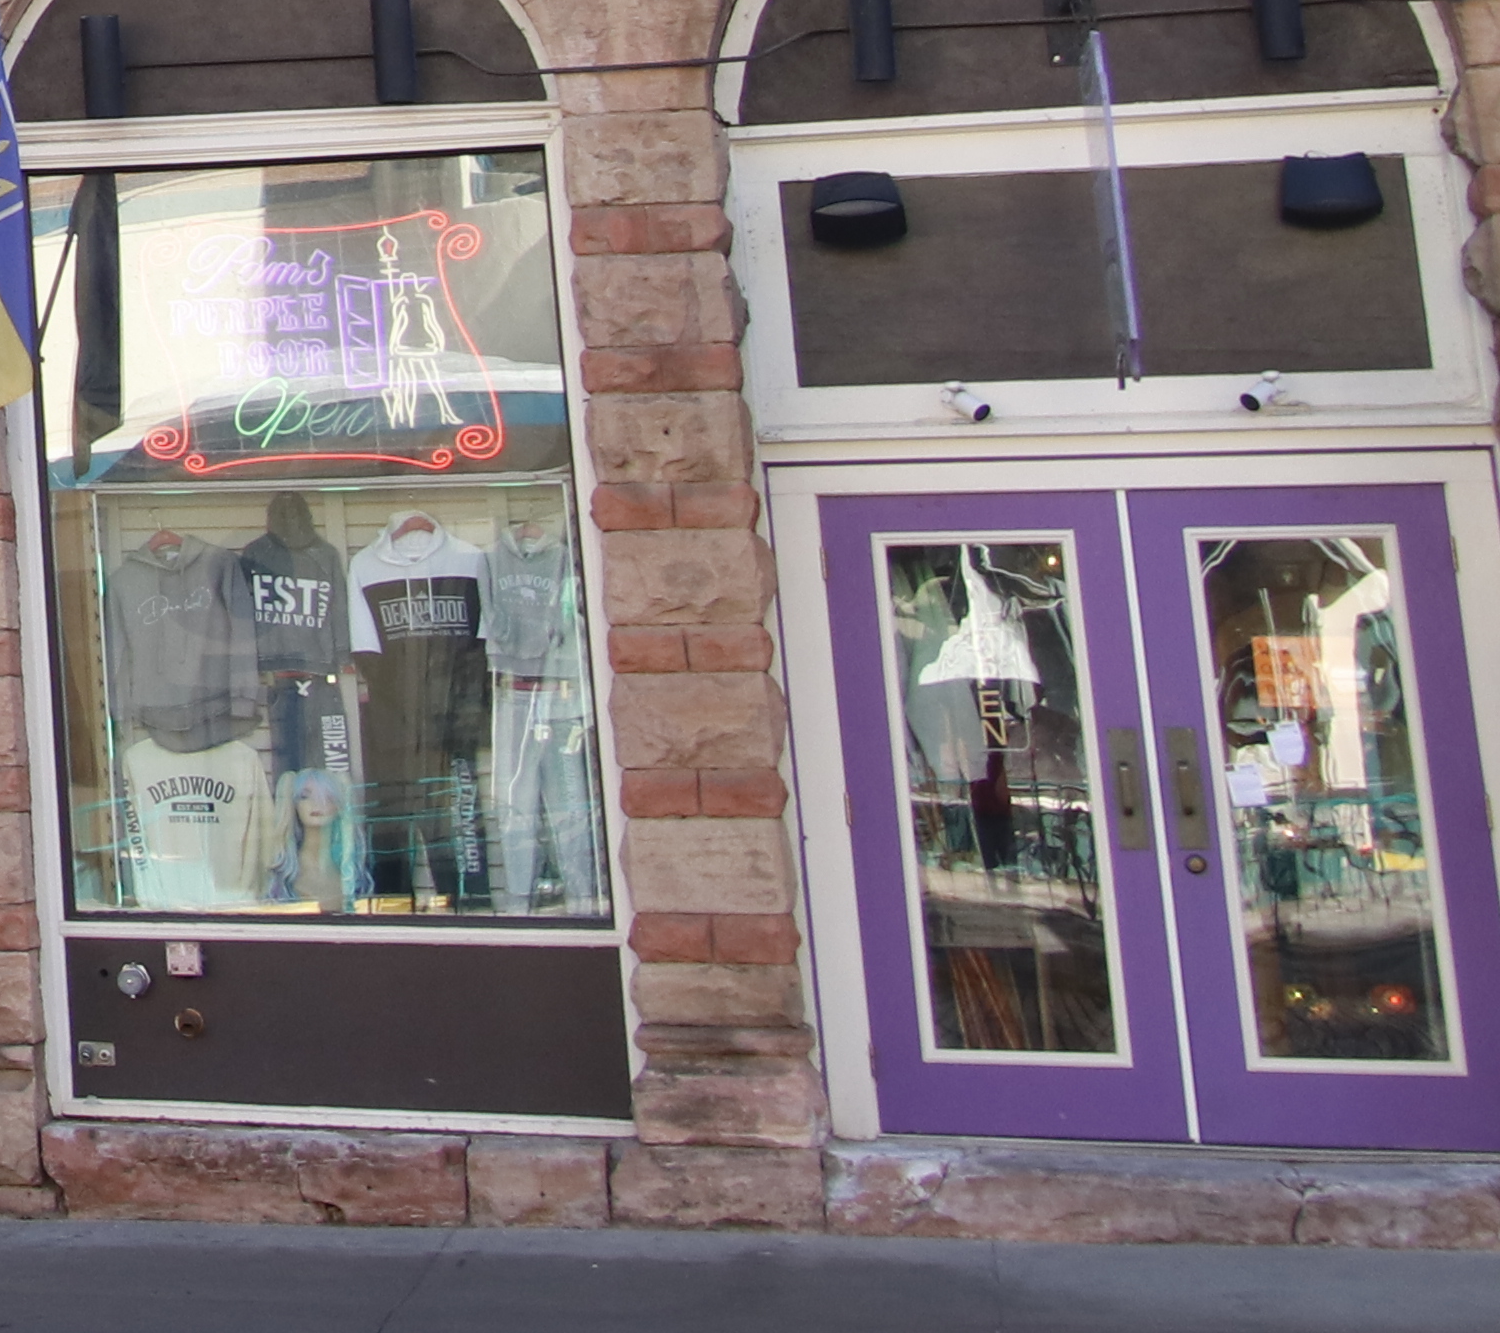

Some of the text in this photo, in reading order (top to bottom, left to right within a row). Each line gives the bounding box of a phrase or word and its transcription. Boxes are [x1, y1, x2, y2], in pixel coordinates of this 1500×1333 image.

[168, 292, 329, 335] PURPLE
[217, 338, 334, 378] DOOR
[234, 377, 374, 449] Open
[252, 574, 318, 616] EST
[146, 775, 236, 805] DEADWOOD
